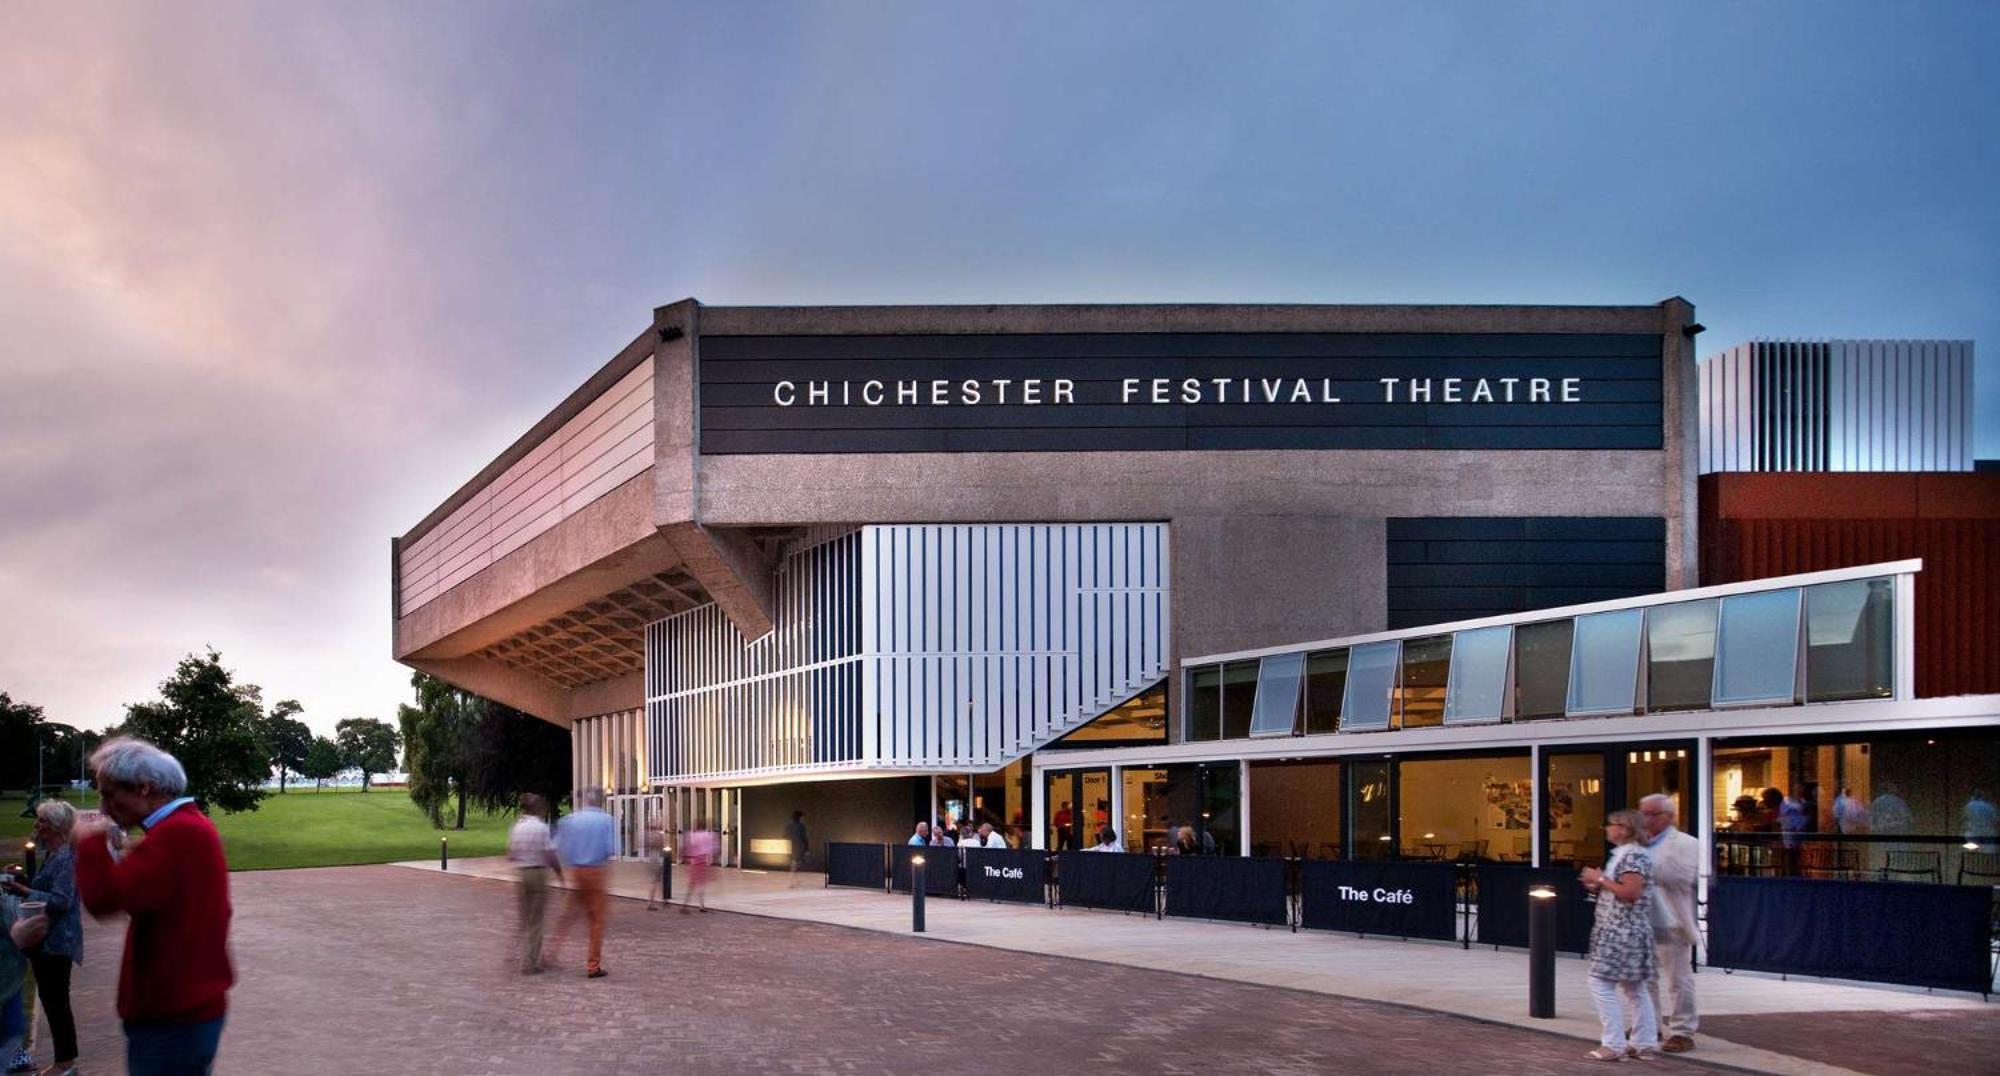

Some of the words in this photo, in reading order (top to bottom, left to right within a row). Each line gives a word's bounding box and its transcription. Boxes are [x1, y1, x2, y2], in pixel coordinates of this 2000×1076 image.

[774, 379, 1074, 406] CHICHESTER
[1122, 378, 1341, 404] FESTIVAL
[1380, 377, 1581, 403] THEATRE
[984, 866, 1000, 877] The
[1002, 867, 1023, 879] Café
[1338, 886, 1369, 902] The
[1373, 887, 1413, 904] Café
